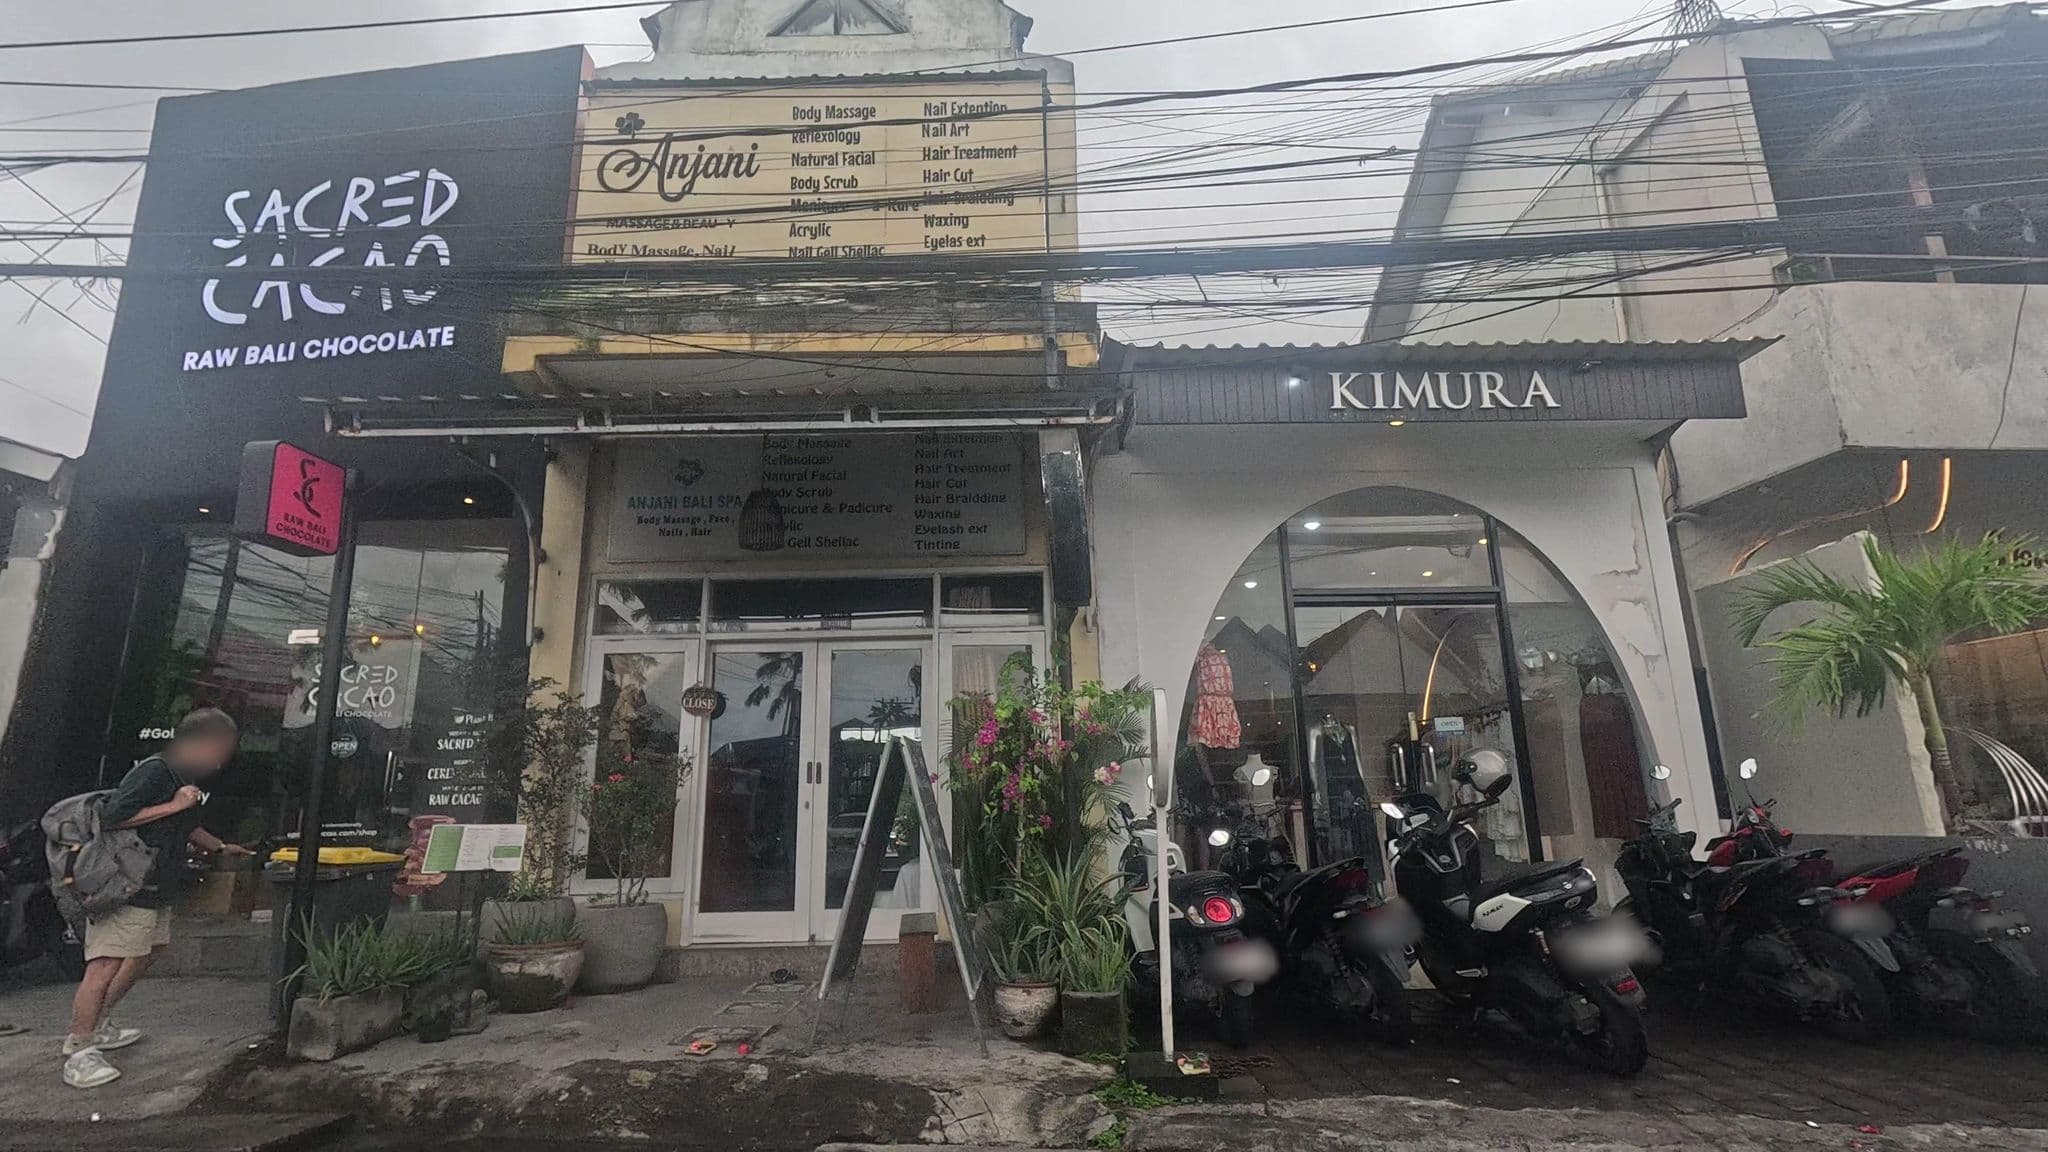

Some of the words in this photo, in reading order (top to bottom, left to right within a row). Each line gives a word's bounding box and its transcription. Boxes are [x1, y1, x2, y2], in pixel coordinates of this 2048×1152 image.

[792, 106, 821, 122] Body
[825, 105, 876, 120] Massage
[924, 102, 947, 116] Nail
[951, 101, 1008, 116] Extention
[792, 129, 861, 145] Reflexology
[922, 124, 946, 137] Nail
[950, 123, 970, 137] Art
[791, 151, 839, 166] Natural
[842, 151, 876, 166] Facial
[922, 145, 950, 160] Hair
[953, 145, 1018, 160] Treatment
[597, 132, 760, 202] Anjani
[923, 168, 950, 182] Hair
[953, 168, 974, 182] Cut
[791, 176, 820, 193] Body
[824, 175, 859, 189] Scrub
[212, 168, 459, 249] SACRED
[924, 213, 969, 228] Waxing
[789, 223, 832, 240] Acrylic
[924, 235, 963, 252] Eyelas
[966, 234, 986, 248] ext
[789, 245, 813, 258] Nail
[817, 245, 838, 258] Gell
[842, 244, 885, 258] Shellac
[202, 234, 451, 326] CACAO
[183, 346, 240, 371] RAW
[244, 341, 295, 365] BALI
[302, 325, 456, 360] CHOCOLATE
[1328, 370, 1561, 410] KIMURA
[915, 448, 939, 459] Nail
[943, 448, 964, 459] Art
[763, 469, 808, 481] Natural
[812, 469, 847, 481] Facial
[915, 463, 941, 474] Hair
[915, 478, 940, 489] Hair
[946, 478, 968, 489] Cut
[796, 486, 833, 498] Scrub
[628, 496, 677, 510] ANJANI
[683, 495, 713, 509] BALI
[717, 494, 743, 509] SPA
[915, 494, 941, 505] Hair
[822, 502, 833, 514] &
[915, 508, 960, 520] Waxing
[283, 512, 304, 526] RAW
[306, 520, 327, 535] BALI
[637, 514, 660, 526] Body
[275, 522, 330, 548] CHOCOLATE
[915, 523, 964, 535] Eyelash
[968, 523, 988, 534] ext
[787, 536, 812, 549] Gell
[815, 535, 860, 548] Shellac
[914, 539, 961, 551] Tinting
[311, 663, 398, 684] SCRED
[308, 686, 395, 708] CCAO
[683, 697, 714, 710] CLOSE
[331, 740, 358, 751] OPEN
[437, 738, 474, 751] SACRED
[428, 794, 449, 806] RAW
